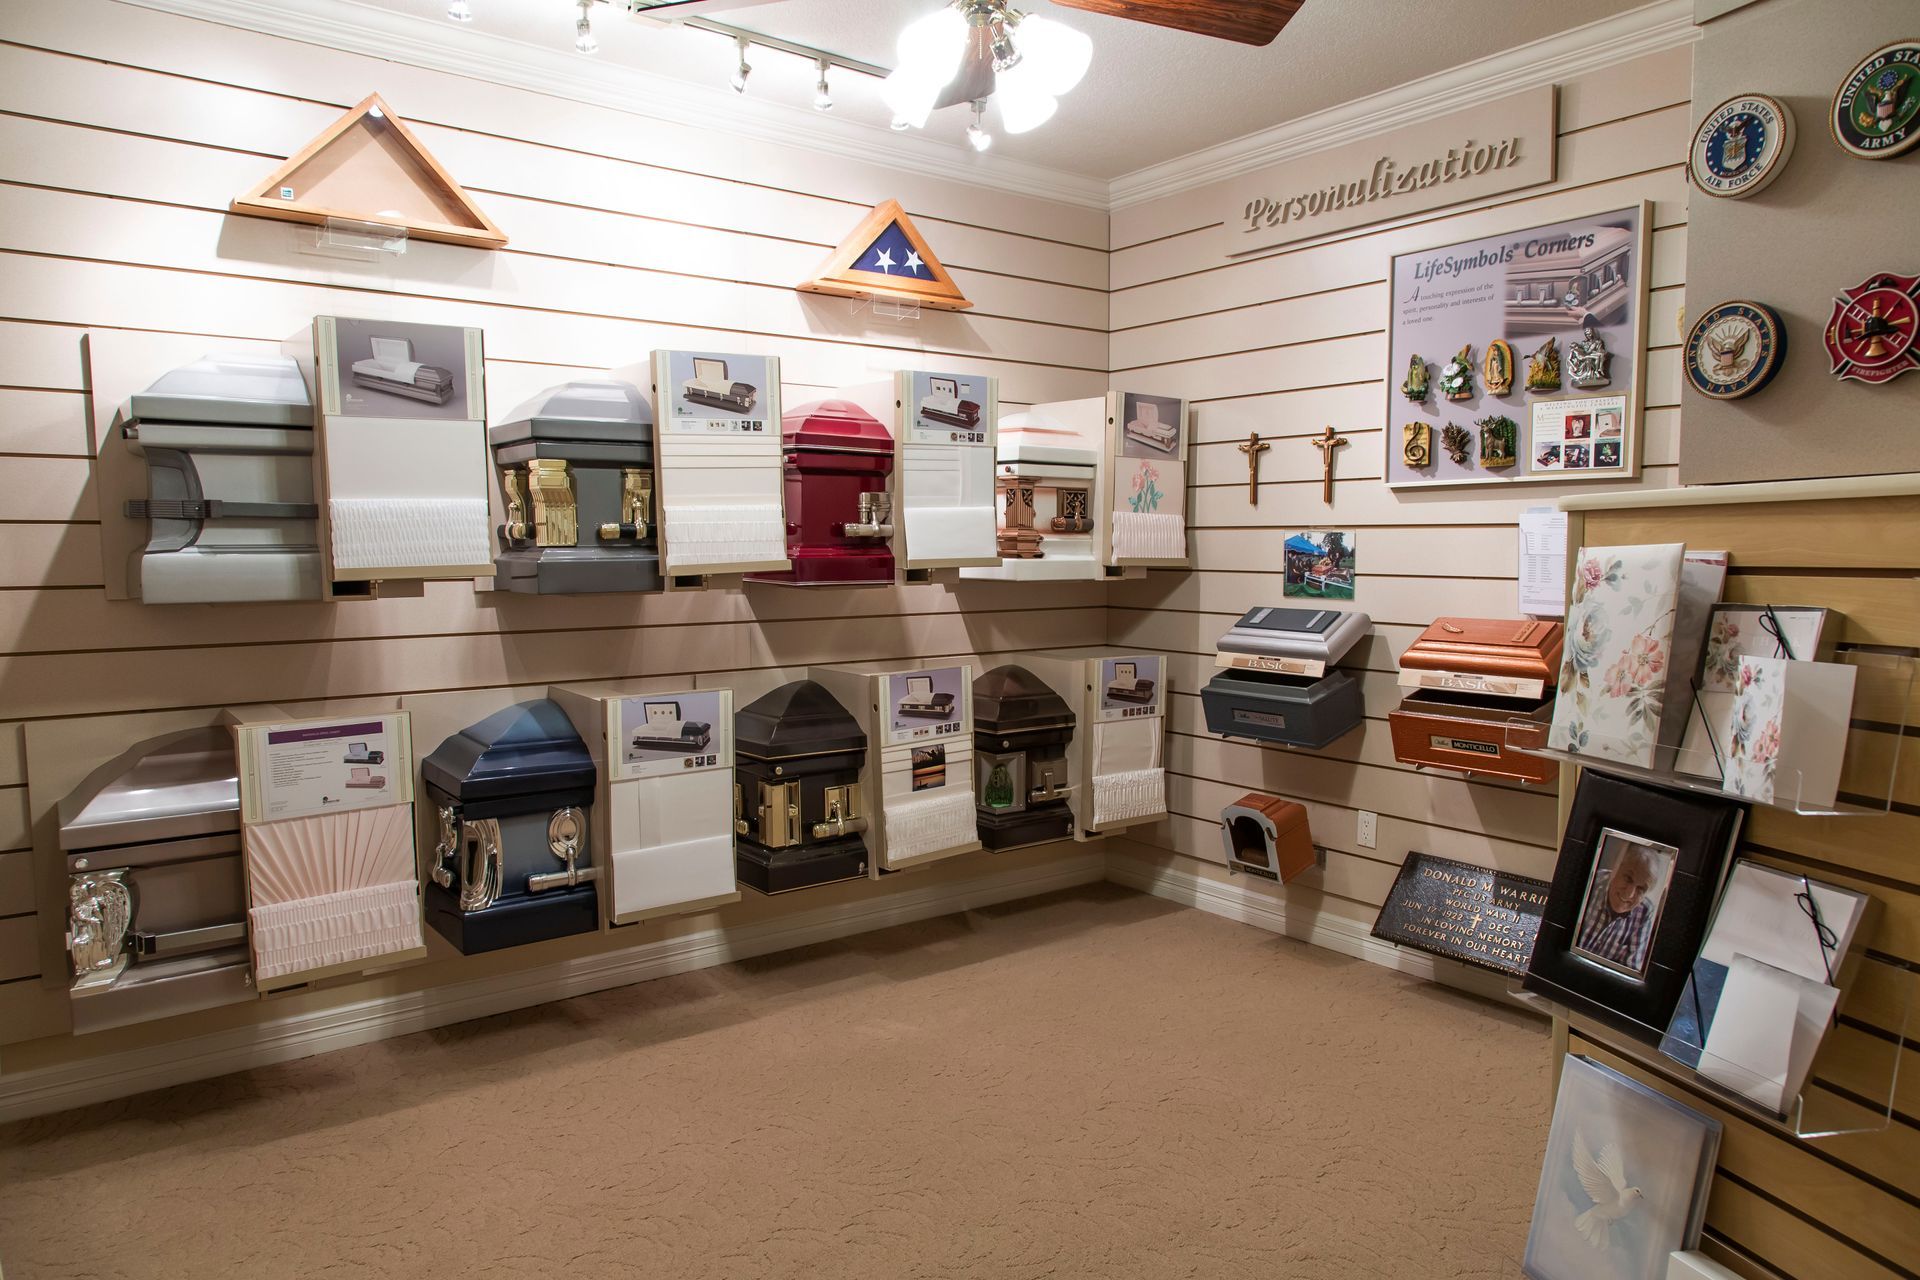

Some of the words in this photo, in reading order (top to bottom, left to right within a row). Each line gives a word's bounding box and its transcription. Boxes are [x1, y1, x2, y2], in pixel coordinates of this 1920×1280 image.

[1841, 57, 1886, 108] UNITED
[1701, 107, 1734, 143] UNITED
[1740, 102, 1774, 125] STATES
[1860, 128, 1907, 149] ARMY
[1243, 136, 1521, 233] Personalization
[1704, 175, 1723, 188] AIR
[1727, 163, 1763, 188] FORCE
[1524, 231, 1596, 259] Corners
[1403, 285, 1421, 304] A
[1421, 290, 1444, 301] touching
[1445, 286, 1475, 297] expression
[1476, 284, 1484, 292] of
[1484, 282, 1494, 291] the
[1419, 302, 1450, 314] personality
[1450, 298, 1461, 307] and
[1462, 296, 1487, 306] interests
[1487, 293, 1495, 301] of
[1406, 317, 1422, 325] loved
[1689, 312, 1721, 369] UNITED
[1737, 307, 1770, 358] STATES
[1851, 360, 1909, 377] FIREFIGHTER
[1706, 378, 1750, 393] NAVY
[1248, 659, 1289, 671] BASIC
[1441, 677, 1495, 691] BASIC
[1453, 741, 1496, 753] MONTICELLO
[1423, 867, 1478, 888] DONALD
[1481, 881, 1494, 893] M
[1445, 898, 1482, 913] WORLD
[1485, 908, 1509, 920] WAR
[1512, 914, 1520, 923] II
[1452, 888, 1470, 900] PFC
[1473, 893, 1486, 902] US
[1490, 897, 1521, 911] ARMY
[1402, 899, 1423, 911] JUN
[1427, 905, 1438, 914] 17
[1442, 909, 1465, 922] 1922
[1488, 922, 1511, 934] DEC
[1518, 930, 1526, 938] 4
[1402, 923, 1447, 942] FOREVER
[1450, 936, 1462, 946] IN
[1466, 940, 1488, 954] OUR
[1420, 916, 1432, 926] IN
[1435, 920, 1474, 937] LOVING
[1478, 932, 1525, 950] MEMORY
